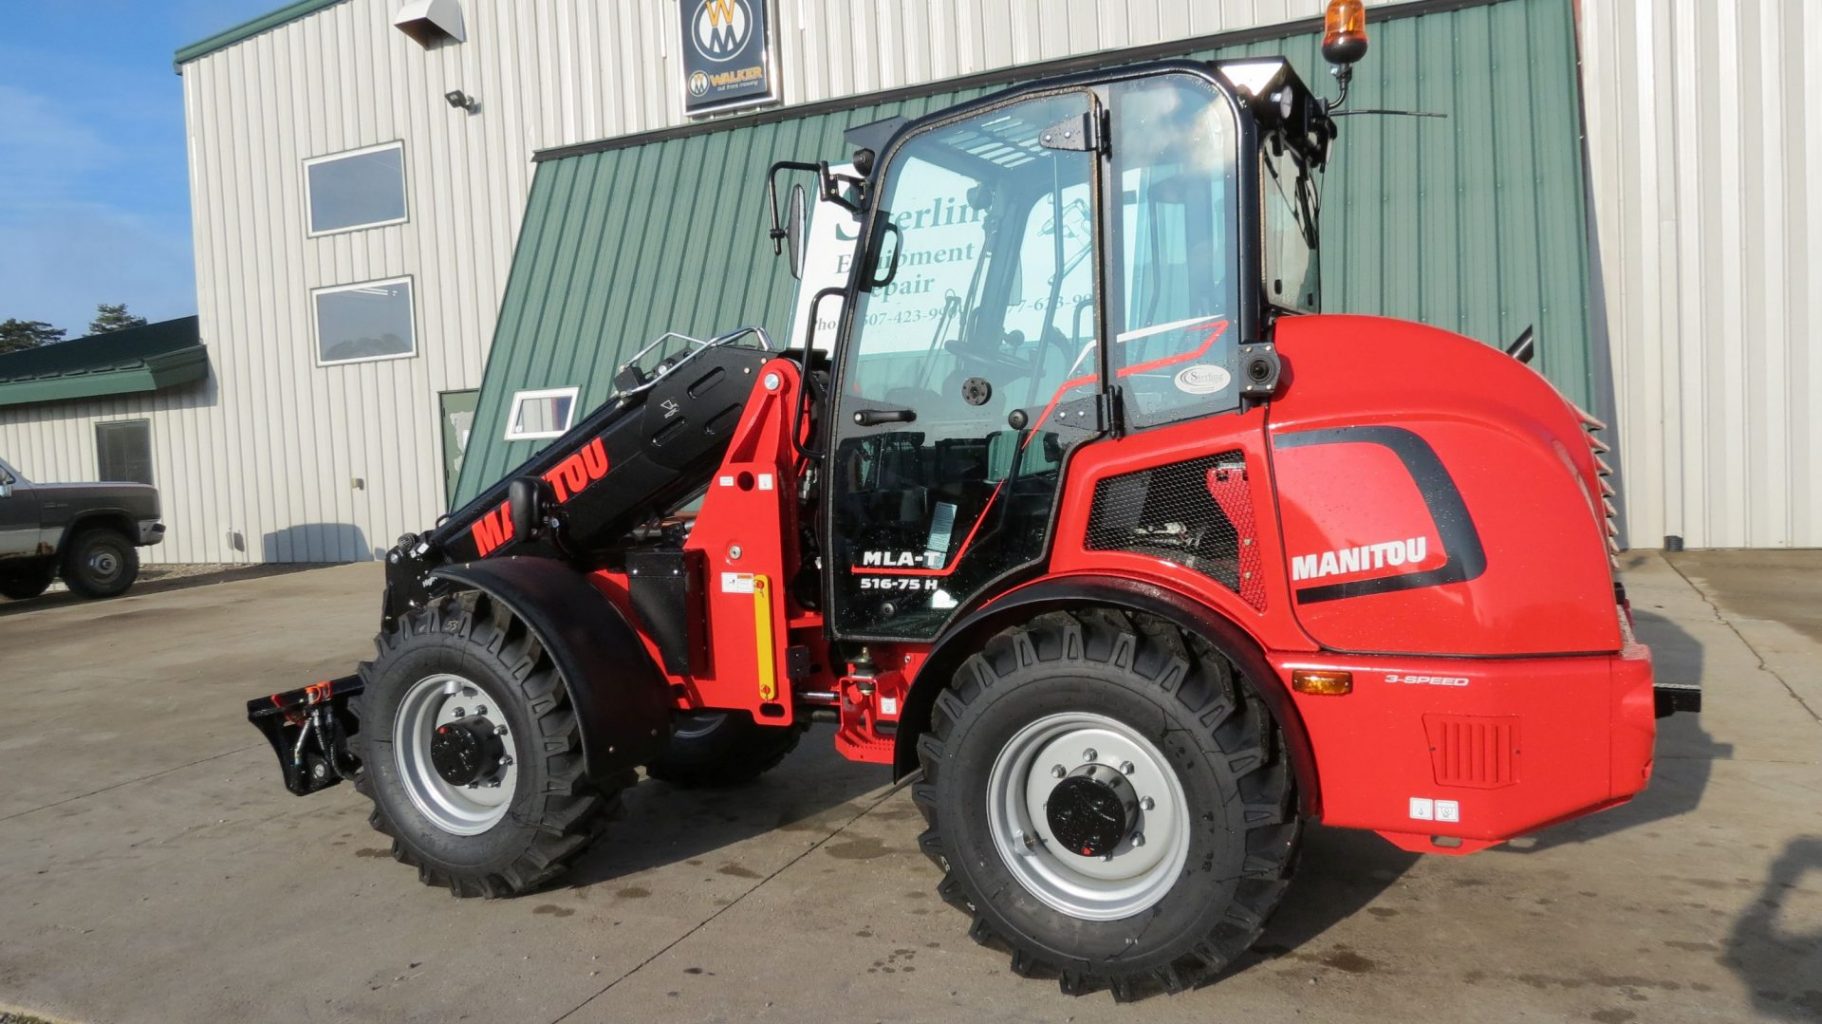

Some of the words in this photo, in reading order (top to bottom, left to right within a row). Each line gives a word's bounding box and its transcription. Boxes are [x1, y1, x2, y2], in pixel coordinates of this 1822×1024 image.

[871, 274, 935, 303] epair
[471, 436, 609, 558] MATOU
[863, 551, 939, 566] MLA-T
[1292, 536, 1426, 580] MANITOU
[860, 578, 920, 589] 516-75
[925, 579, 938, 590] H
[1384, 674, 1469, 687] 3-SPEED
